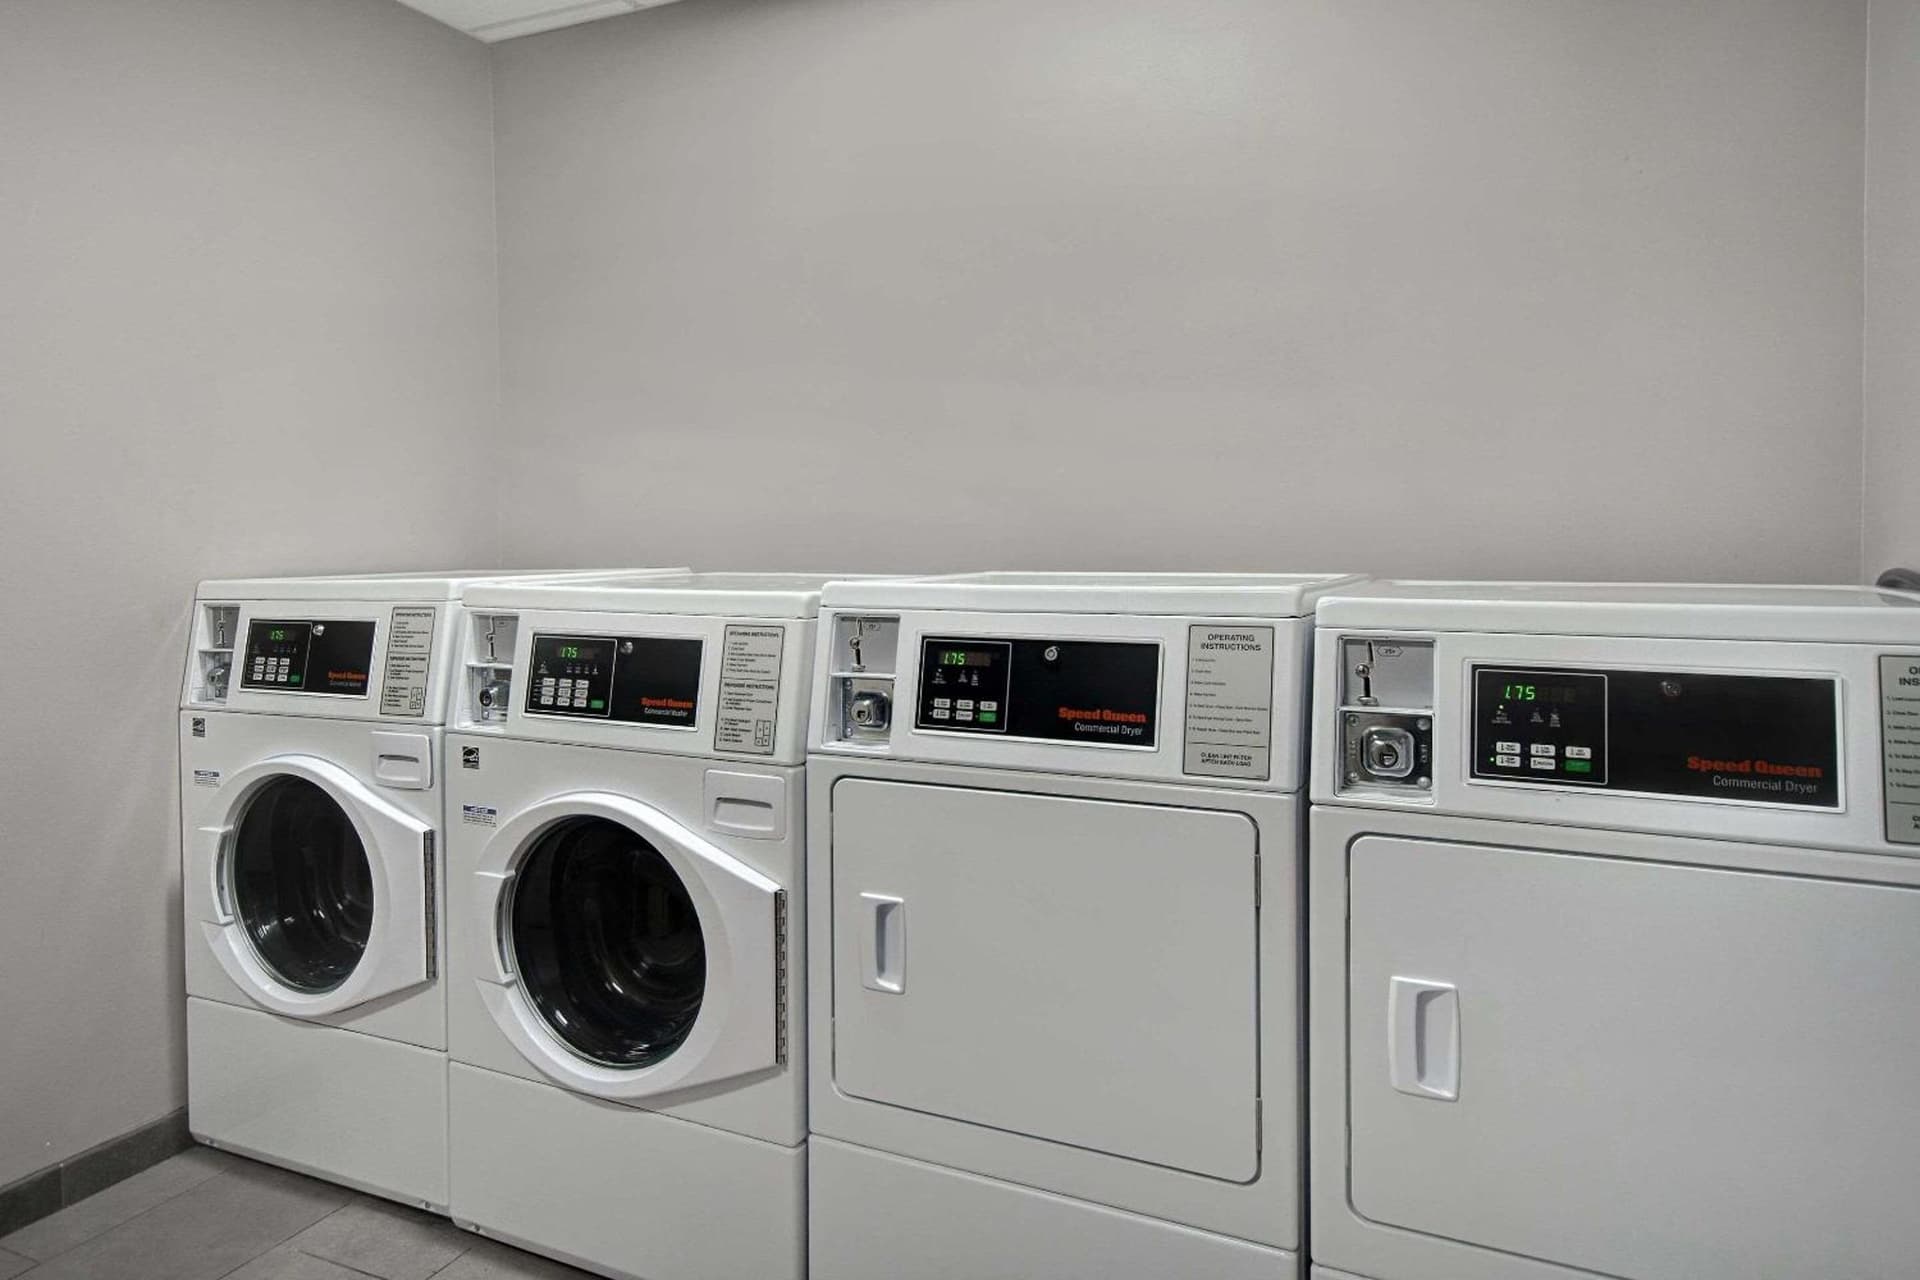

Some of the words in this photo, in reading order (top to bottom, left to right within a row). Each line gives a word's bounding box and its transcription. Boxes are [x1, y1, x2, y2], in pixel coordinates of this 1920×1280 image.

[1207, 633, 1255, 642] OPERATING
[1200, 643, 1261, 651] INSTRUCTIONS
[1059, 707, 1101, 720] Speed
[1103, 709, 1146, 723] Queen
[1074, 721, 1119, 734] Commercial
[1121, 725, 1143, 736] Dryer
[1687, 756, 1751, 772] Speed
[1754, 760, 1823, 777] Queen
[1713, 775, 1782, 791] Commercial
[1785, 780, 1818, 793] Dryer
